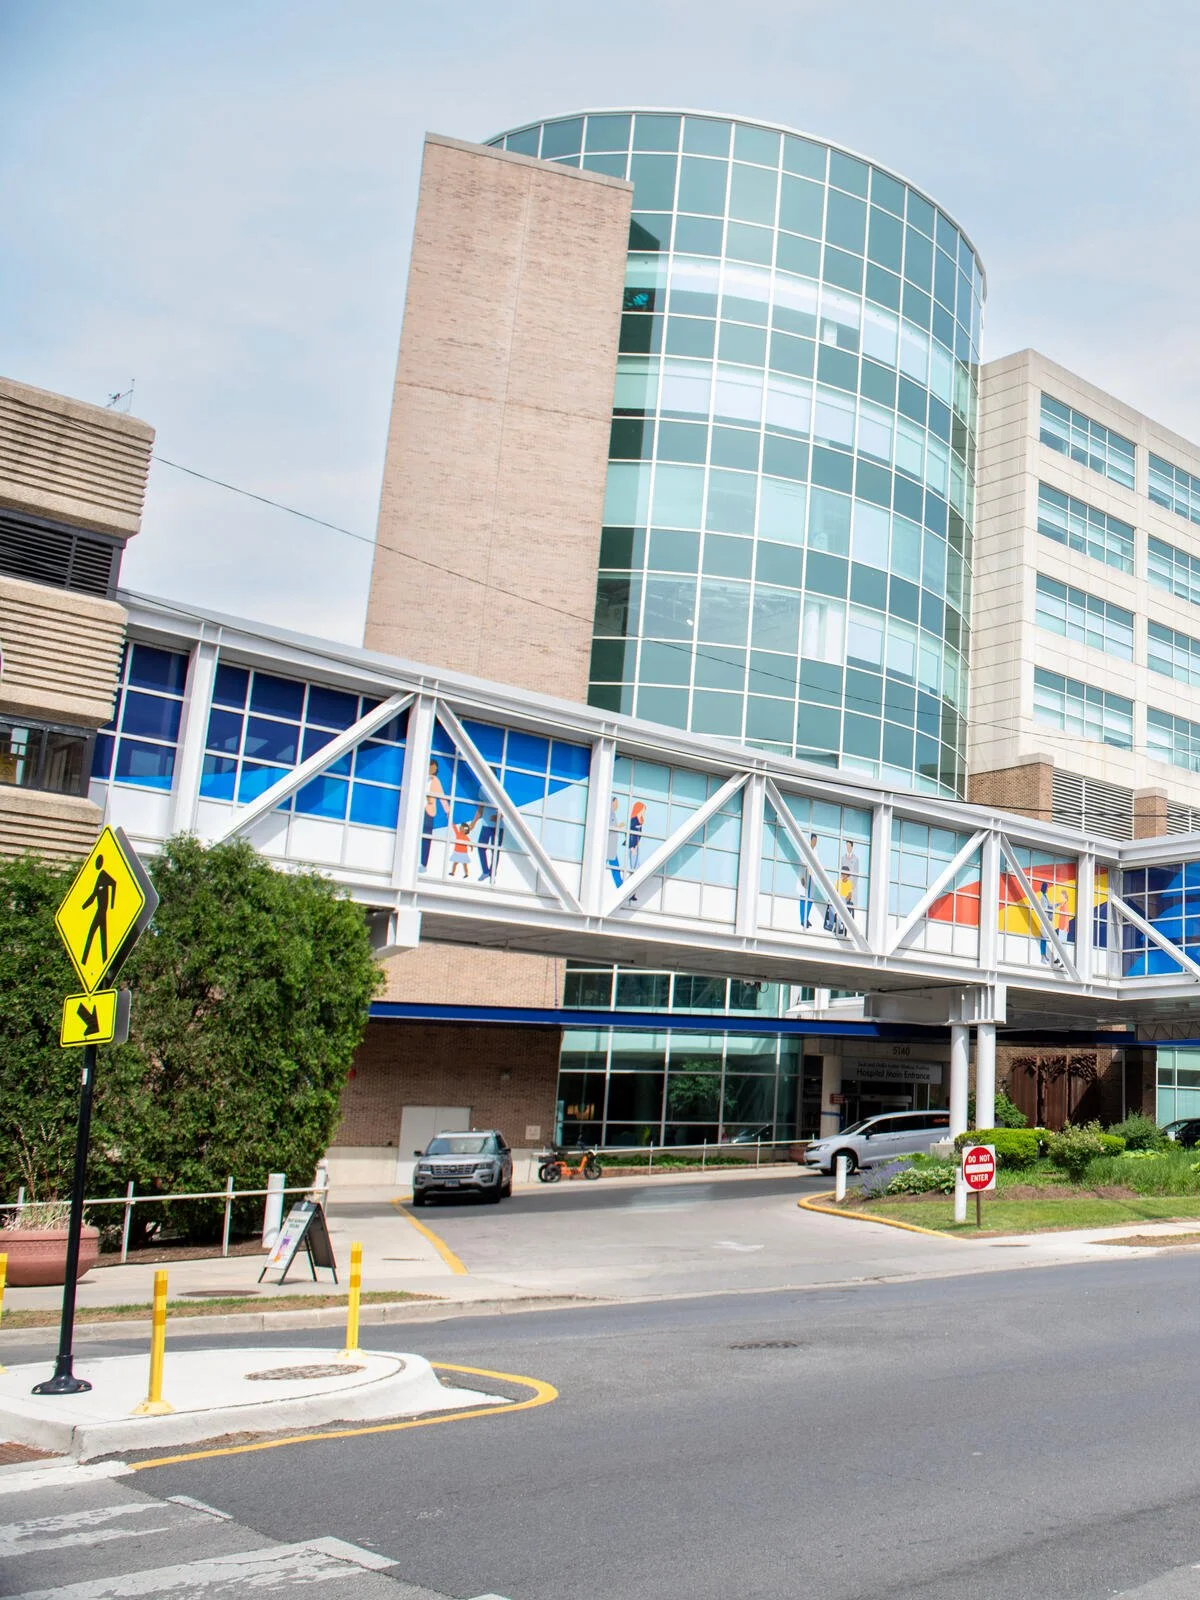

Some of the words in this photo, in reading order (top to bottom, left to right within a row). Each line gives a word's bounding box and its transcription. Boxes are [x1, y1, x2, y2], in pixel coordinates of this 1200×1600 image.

[892, 1046, 911, 1056] 5140
[856, 1067, 884, 1078] Hospital
[885, 1069, 903, 1079] Main
[903, 1070, 930, 1080] Entrance
[967, 1155, 977, 1163] DO
[979, 1154, 991, 1163] NOT
[970, 1173, 989, 1183] ENTER
